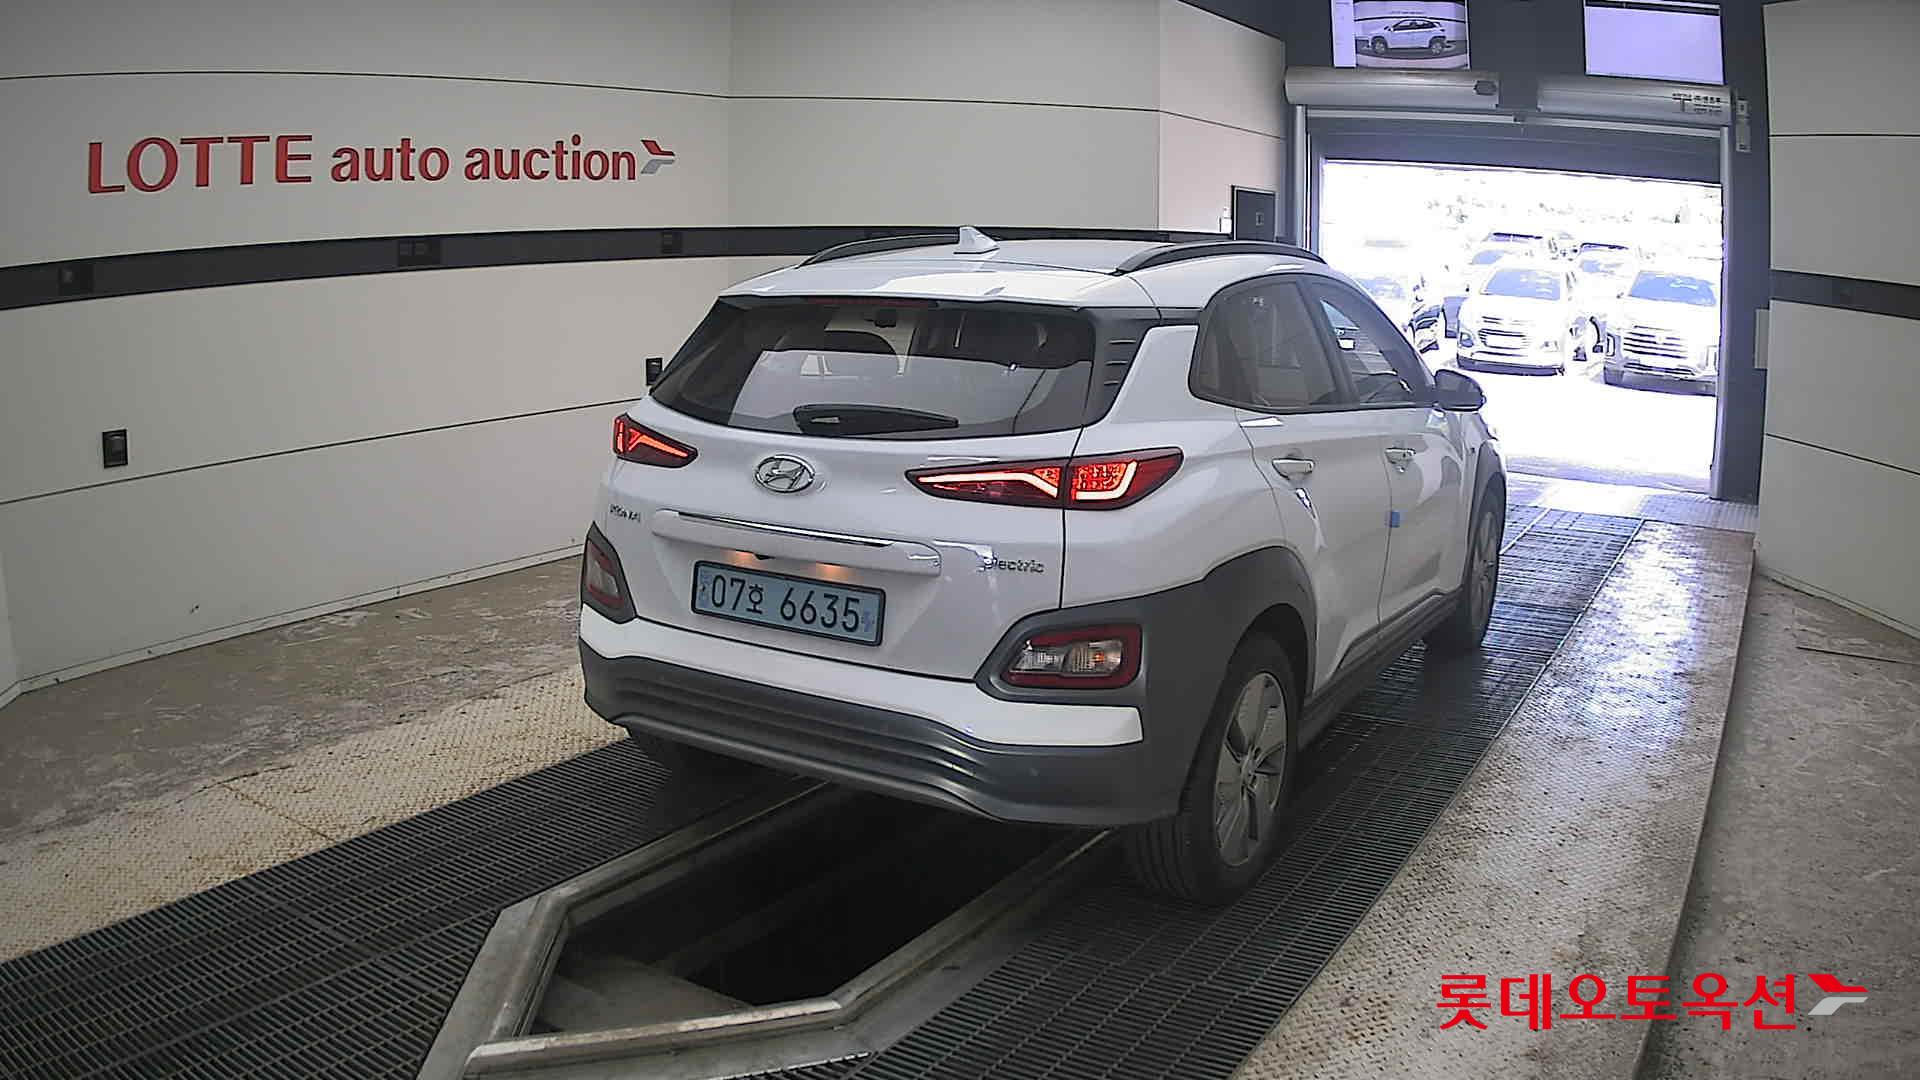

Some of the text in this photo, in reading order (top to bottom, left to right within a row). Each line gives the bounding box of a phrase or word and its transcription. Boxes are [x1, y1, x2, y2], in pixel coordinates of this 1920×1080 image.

[88, 134, 637, 194] LOTTE auto auction
[711, 574, 861, 633] 07호 6635
